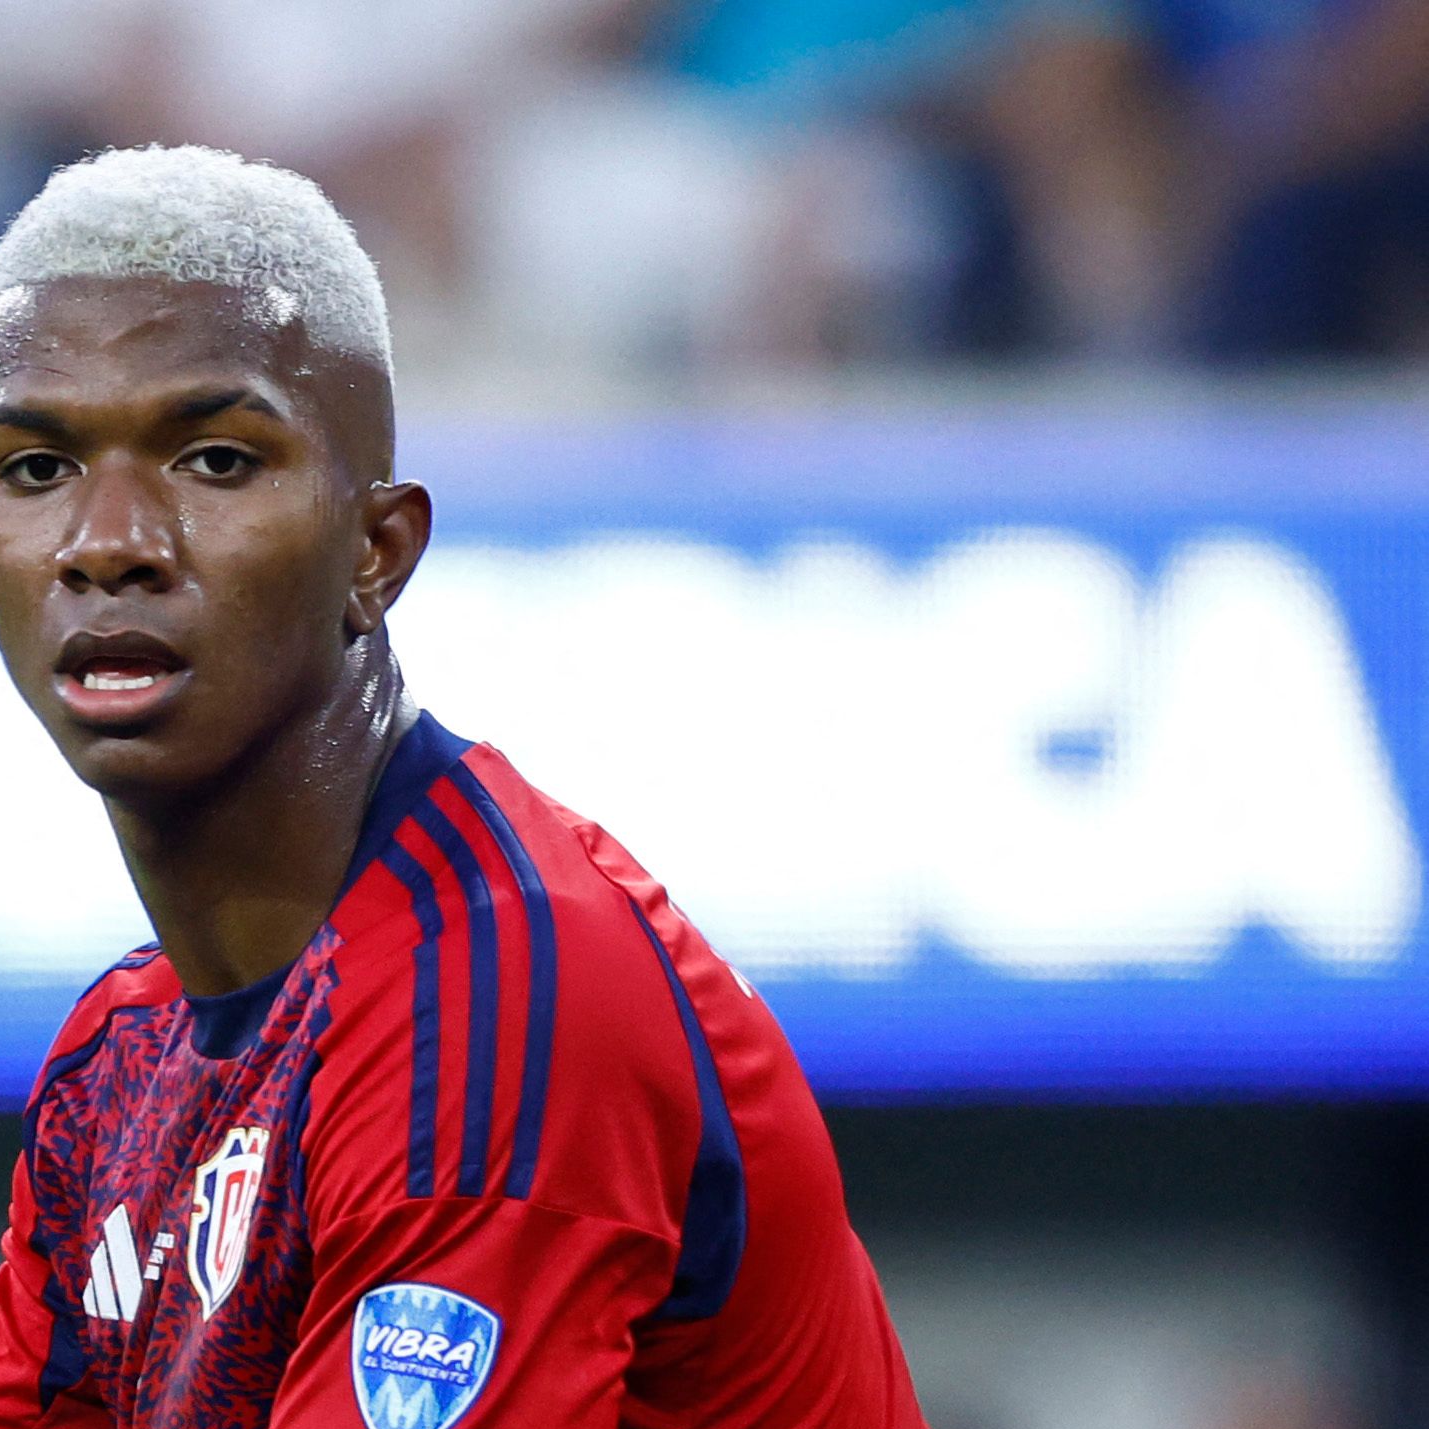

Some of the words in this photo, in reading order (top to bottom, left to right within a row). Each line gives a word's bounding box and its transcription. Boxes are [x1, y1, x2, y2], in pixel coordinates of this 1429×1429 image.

[365, 1325, 476, 1370] VIBRA
[363, 1356, 378, 1368] EL
[381, 1356, 469, 1384] CONTINENTE
